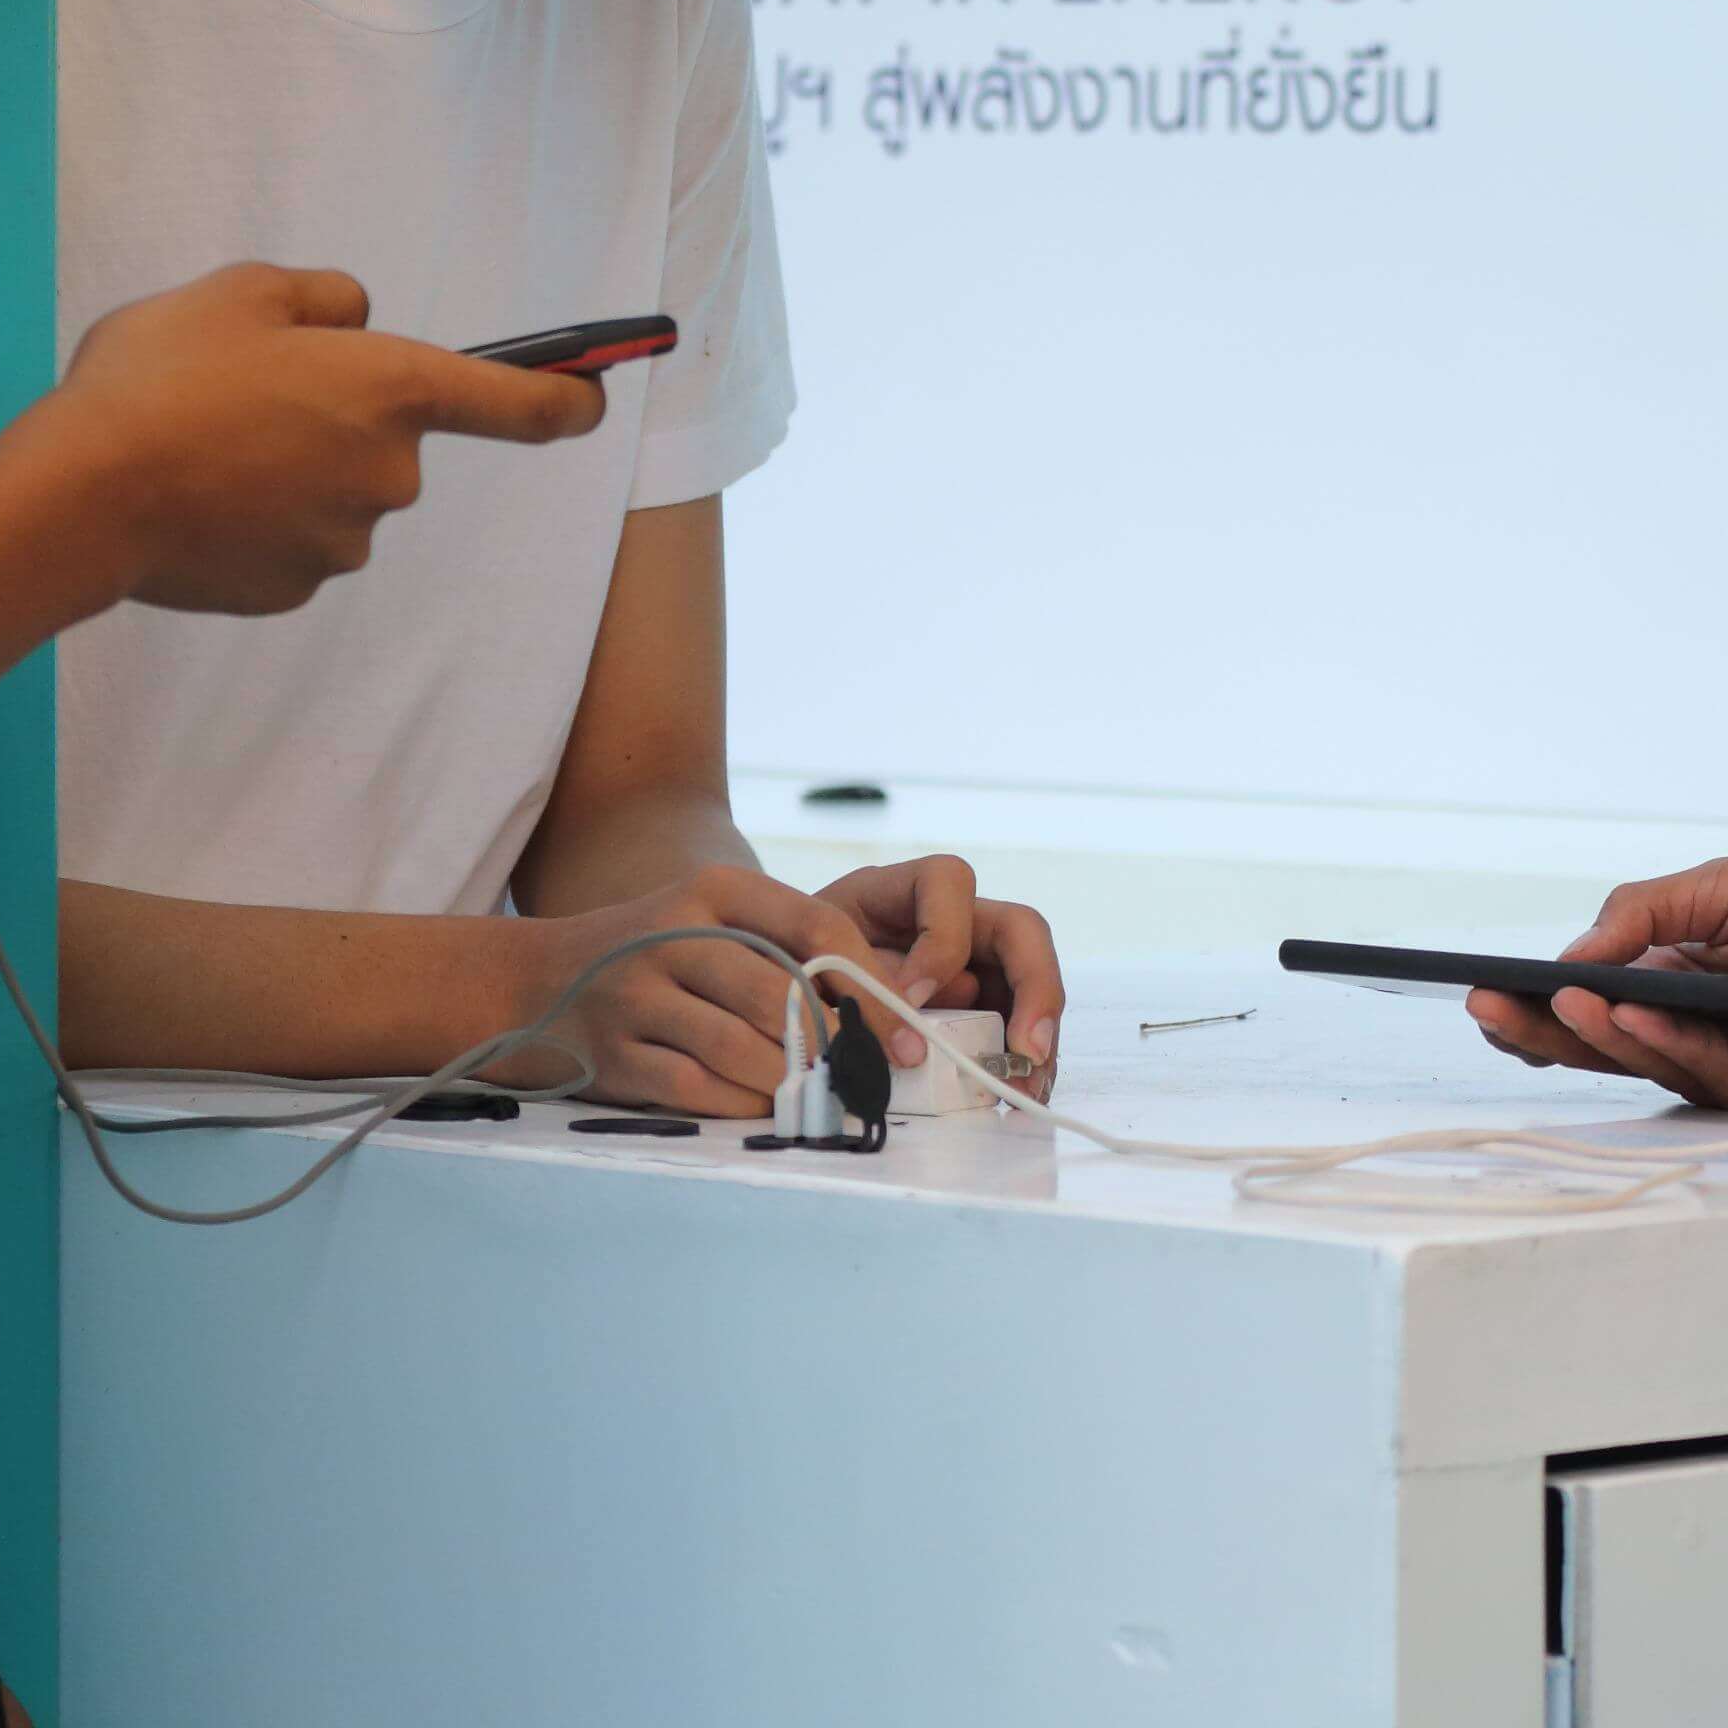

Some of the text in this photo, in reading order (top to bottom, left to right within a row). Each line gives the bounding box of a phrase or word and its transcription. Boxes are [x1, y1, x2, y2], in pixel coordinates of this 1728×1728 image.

[862, 25, 1439, 156] สู่พลังงานที่ยั่งยืน
